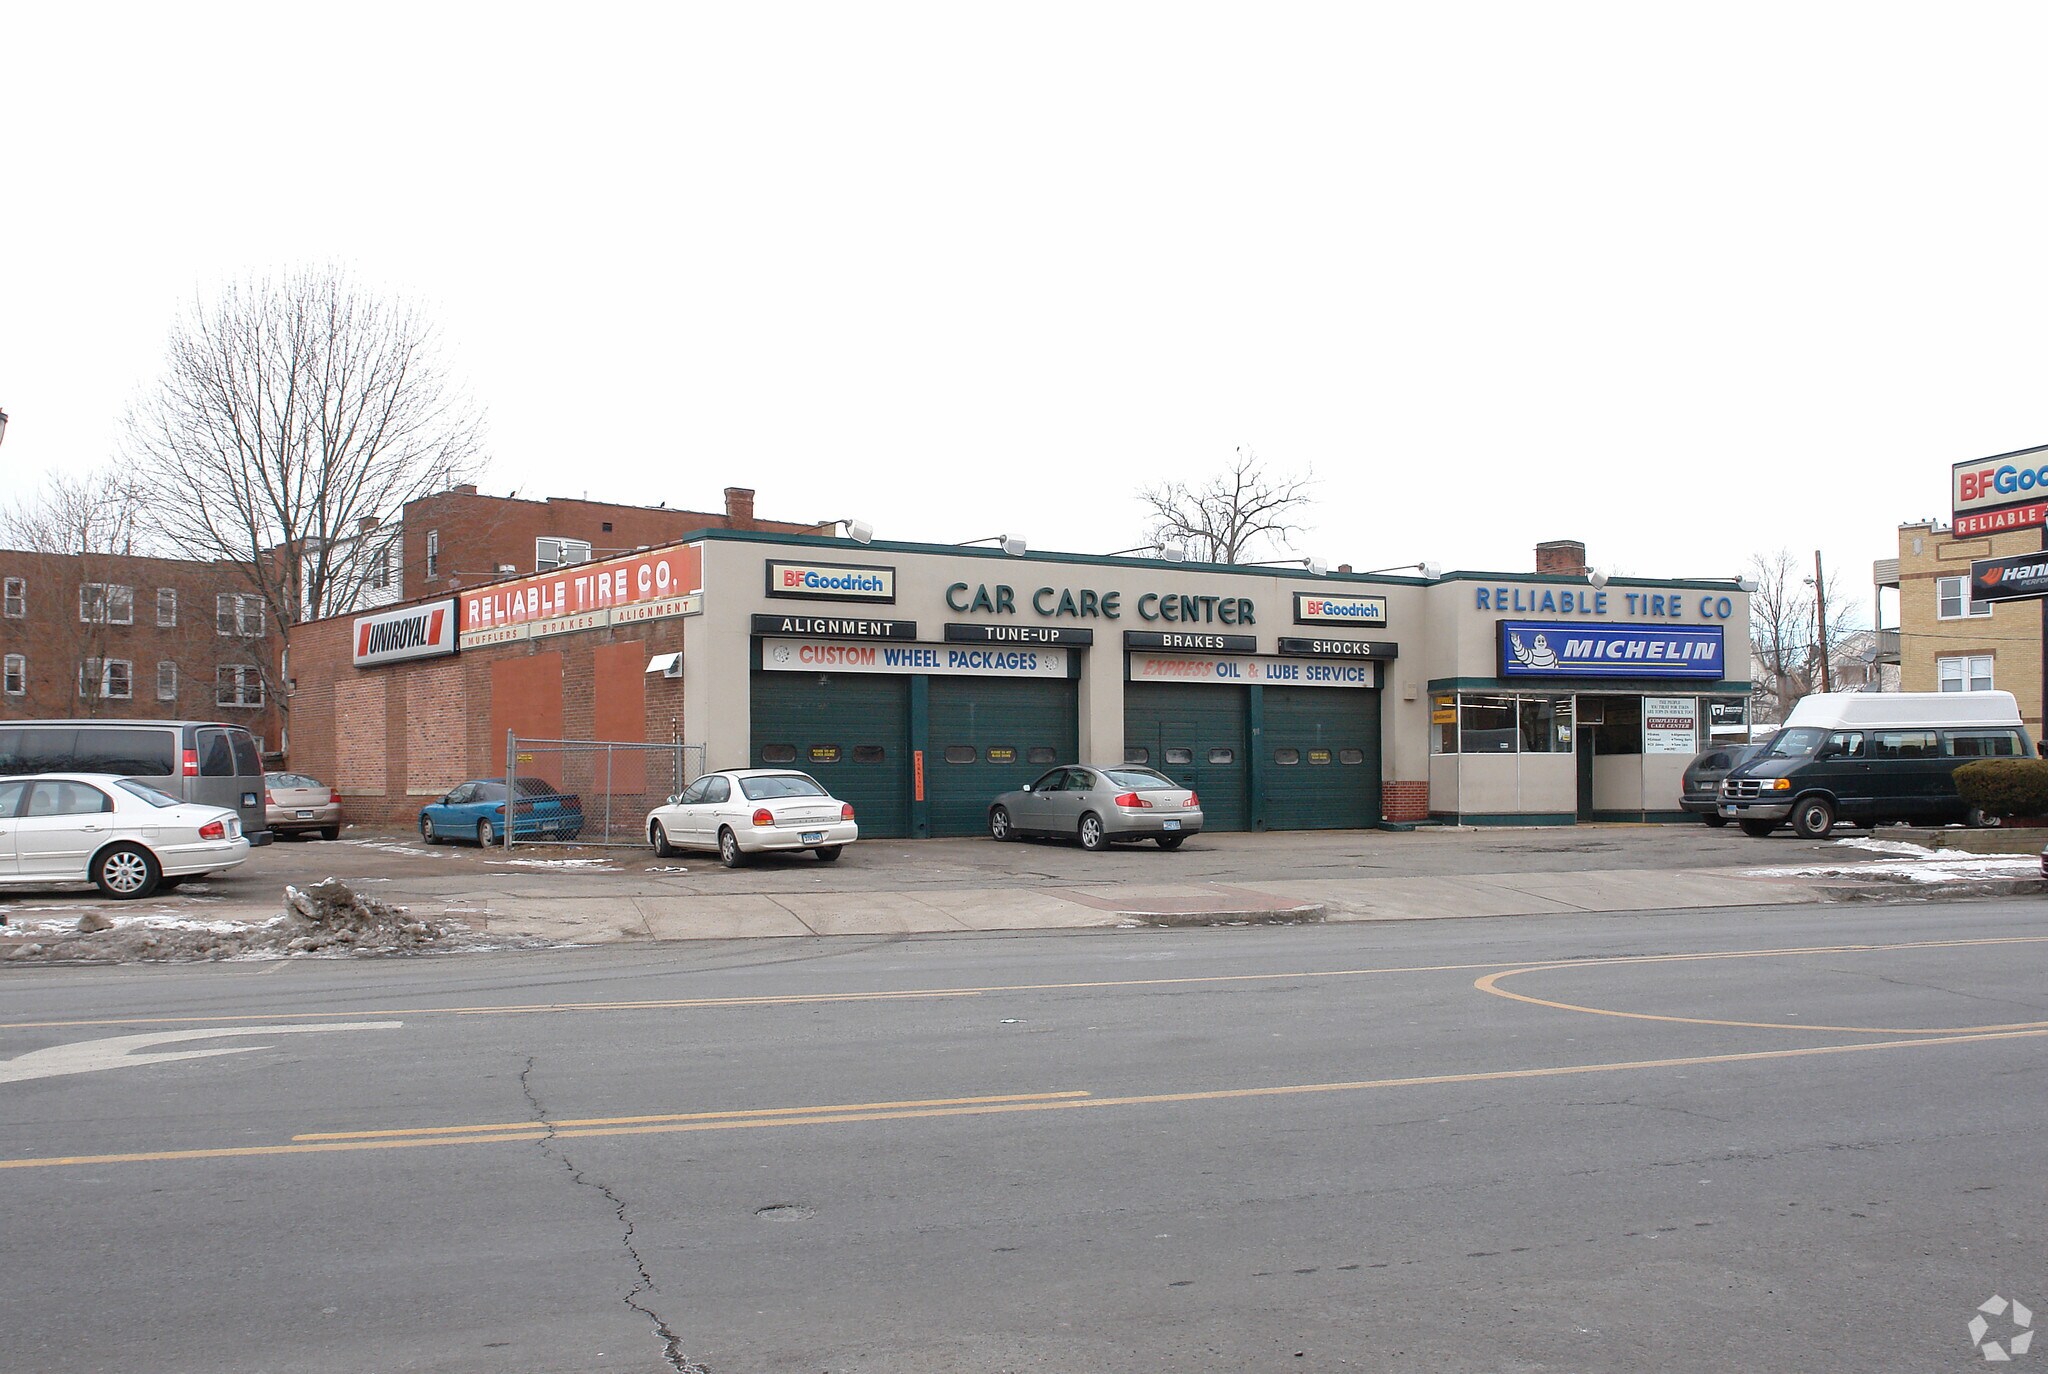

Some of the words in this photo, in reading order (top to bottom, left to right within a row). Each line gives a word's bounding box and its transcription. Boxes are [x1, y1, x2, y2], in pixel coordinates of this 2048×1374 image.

[1958, 508, 2036, 533] RELIABLE
[783, 569, 883, 592] BFGoodrich
[468, 581, 566, 623] RELIABLE
[575, 568, 628, 601] TIRE
[638, 560, 678, 592] CO.
[618, 601, 689, 622] ALIGNMENT
[946, 582, 1016, 615] CAR
[1032, 587, 1120, 619] CARE
[1138, 592, 1256, 625] CENTER
[1308, 600, 1379, 618] BFGoodrich
[1476, 587, 1607, 614] RELIABLE
[1625, 593, 1682, 617] TIRE
[1700, 596, 1733, 618] CO
[369, 615, 428, 654] UNIROYAL
[542, 617, 594, 634] BRAKES
[781, 619, 894, 636] ALIGNMENT
[985, 628, 1060, 643] TUNE-UP
[467, 630, 518, 646] MUFFLERS
[1163, 634, 1224, 648] BRAKES
[1313, 641, 1370, 655] SHOCKS
[799, 645, 876, 666] CUSTOM
[884, 649, 941, 668] WHEEL
[948, 650, 1037, 671] PACKAGES
[1563, 639, 1716, 660] MICHELIN
[1143, 659, 1214, 677] EXPRESS
[1216, 662, 1241, 678] OIL
[1248, 663, 1259, 678] &
[1266, 664, 1299, 680] LUBE
[1306, 666, 1365, 681] SERVICE
